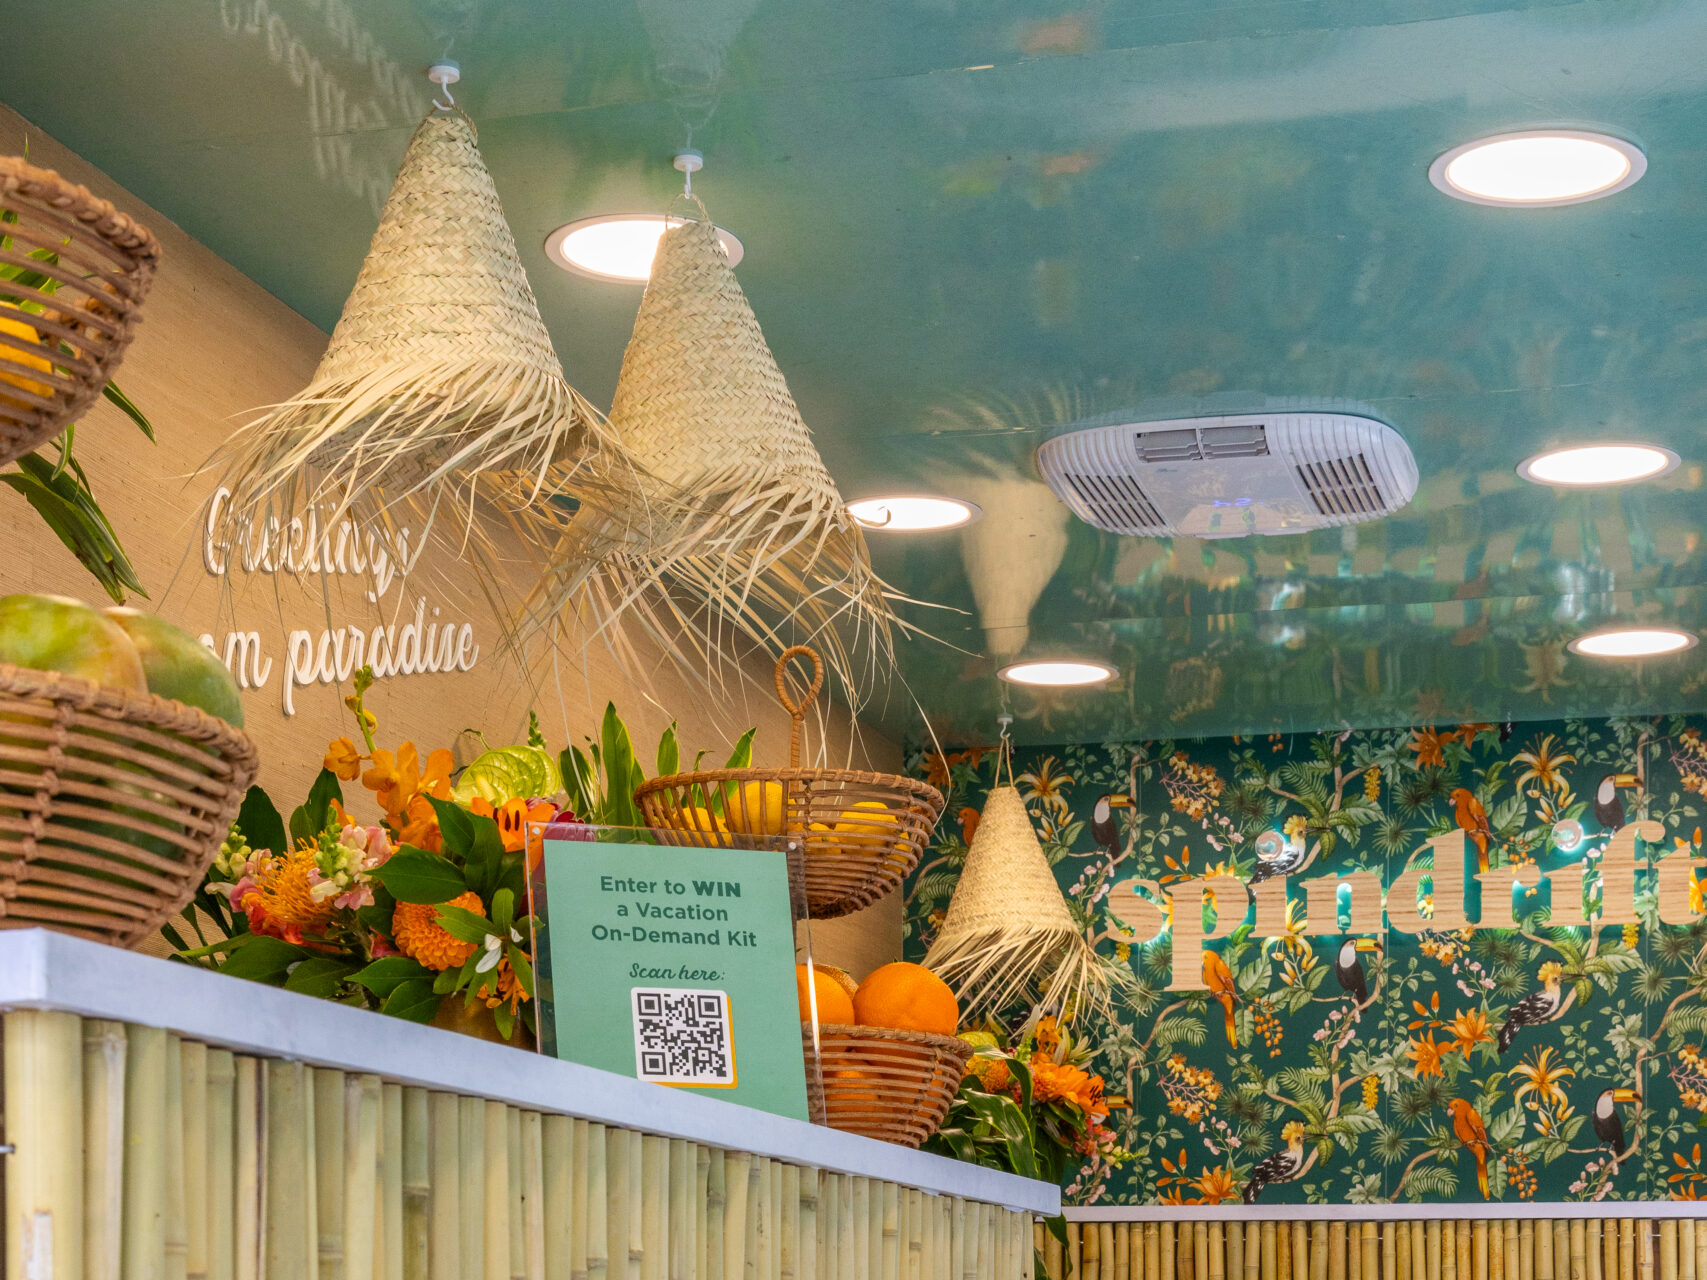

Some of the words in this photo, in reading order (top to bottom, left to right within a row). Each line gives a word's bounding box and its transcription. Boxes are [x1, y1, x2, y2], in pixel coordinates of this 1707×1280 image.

[283, 596, 480, 716] paradise
[600, 875, 657, 895] Enter
[663, 878, 686, 896] to
[692, 879, 741, 898] WIN
[616, 904, 629, 918] a
[636, 902, 729, 922] Vacation
[1105, 820, 1707, 992] spindrift
[591, 924, 721, 947] On-Demand
[728, 930, 757, 948] Kit
[628, 962, 676, 981] Scan
[676, 964, 726, 982] here:
